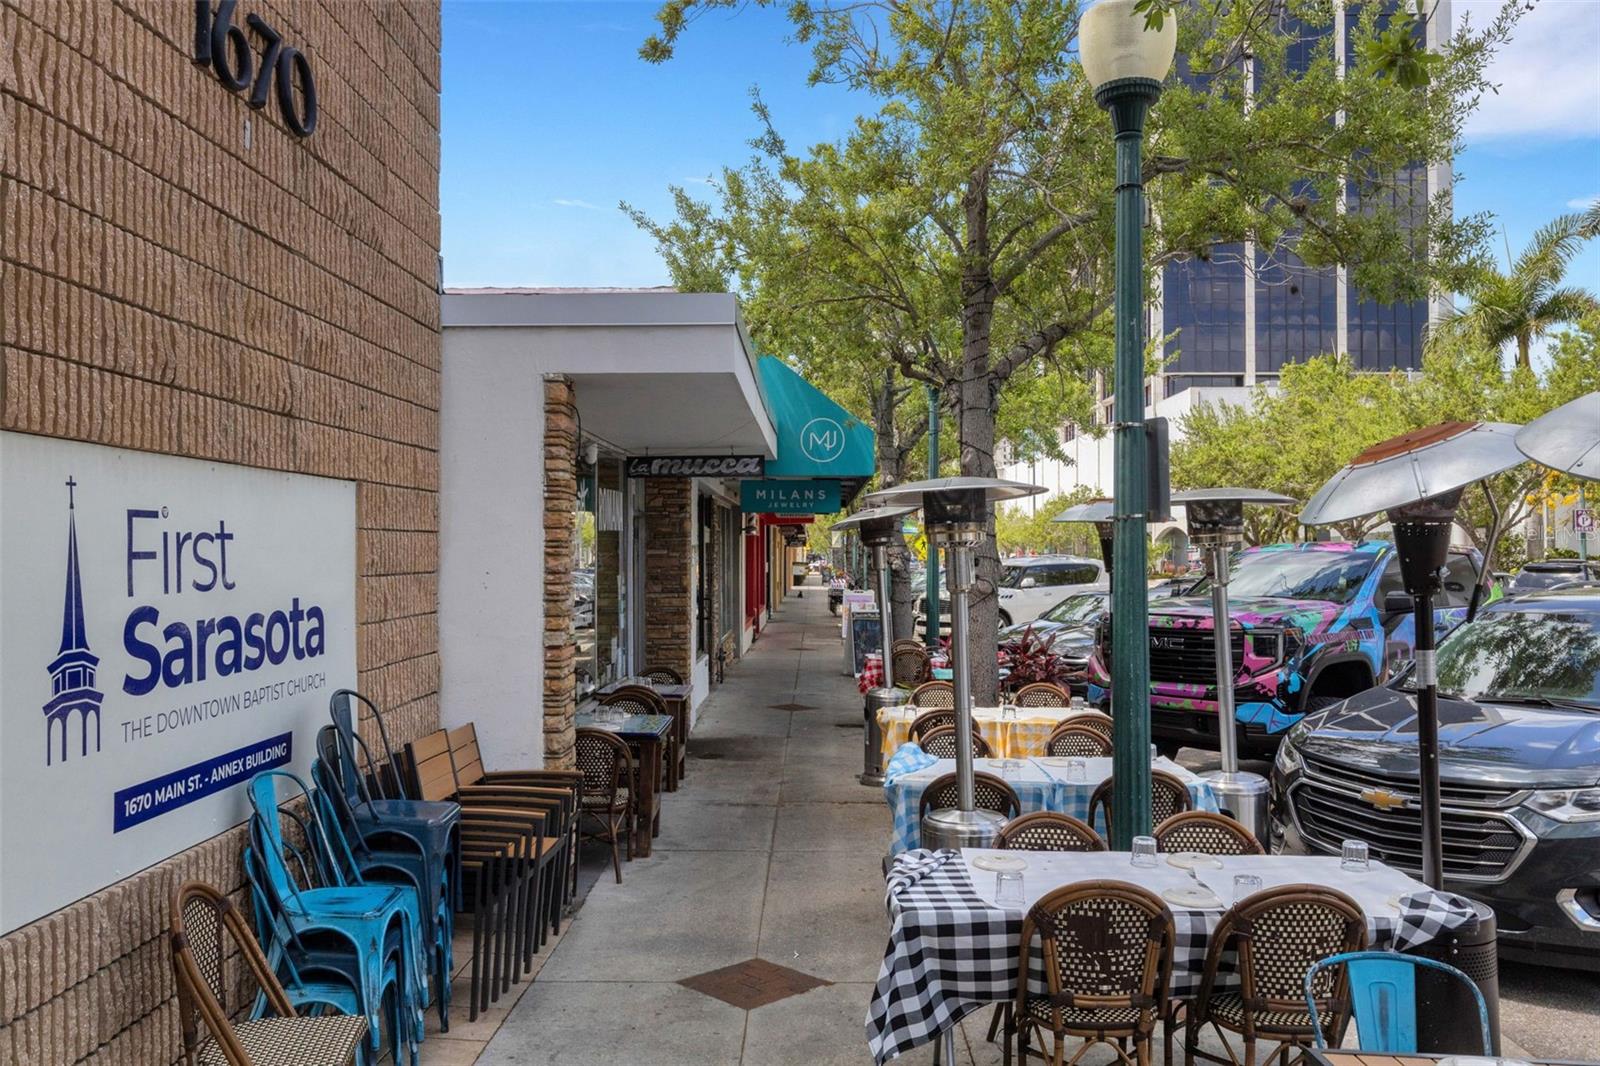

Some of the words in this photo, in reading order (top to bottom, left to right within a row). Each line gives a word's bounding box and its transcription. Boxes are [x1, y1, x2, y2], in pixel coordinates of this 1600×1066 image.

[194, 0, 317, 138] 1670
[650, 457, 761, 475] mucca
[756, 489, 827, 500] MILANS
[126, 506, 236, 598] First
[122, 597, 325, 697] Sarasota
[1150, 637, 1185, 649] MC
[121, 716, 152, 743] THE
[157, 694, 240, 734] DOWNTOWN
[244, 681, 285, 710] BAPTIST
[288, 671, 326, 697] CHURCH
[124, 792, 151, 817] 1670
[155, 781, 186, 806] MAIN
[187, 774, 203, 793] ST.
[210, 757, 244, 784] ANNEX
[246, 743, 287, 770] BUILDING
